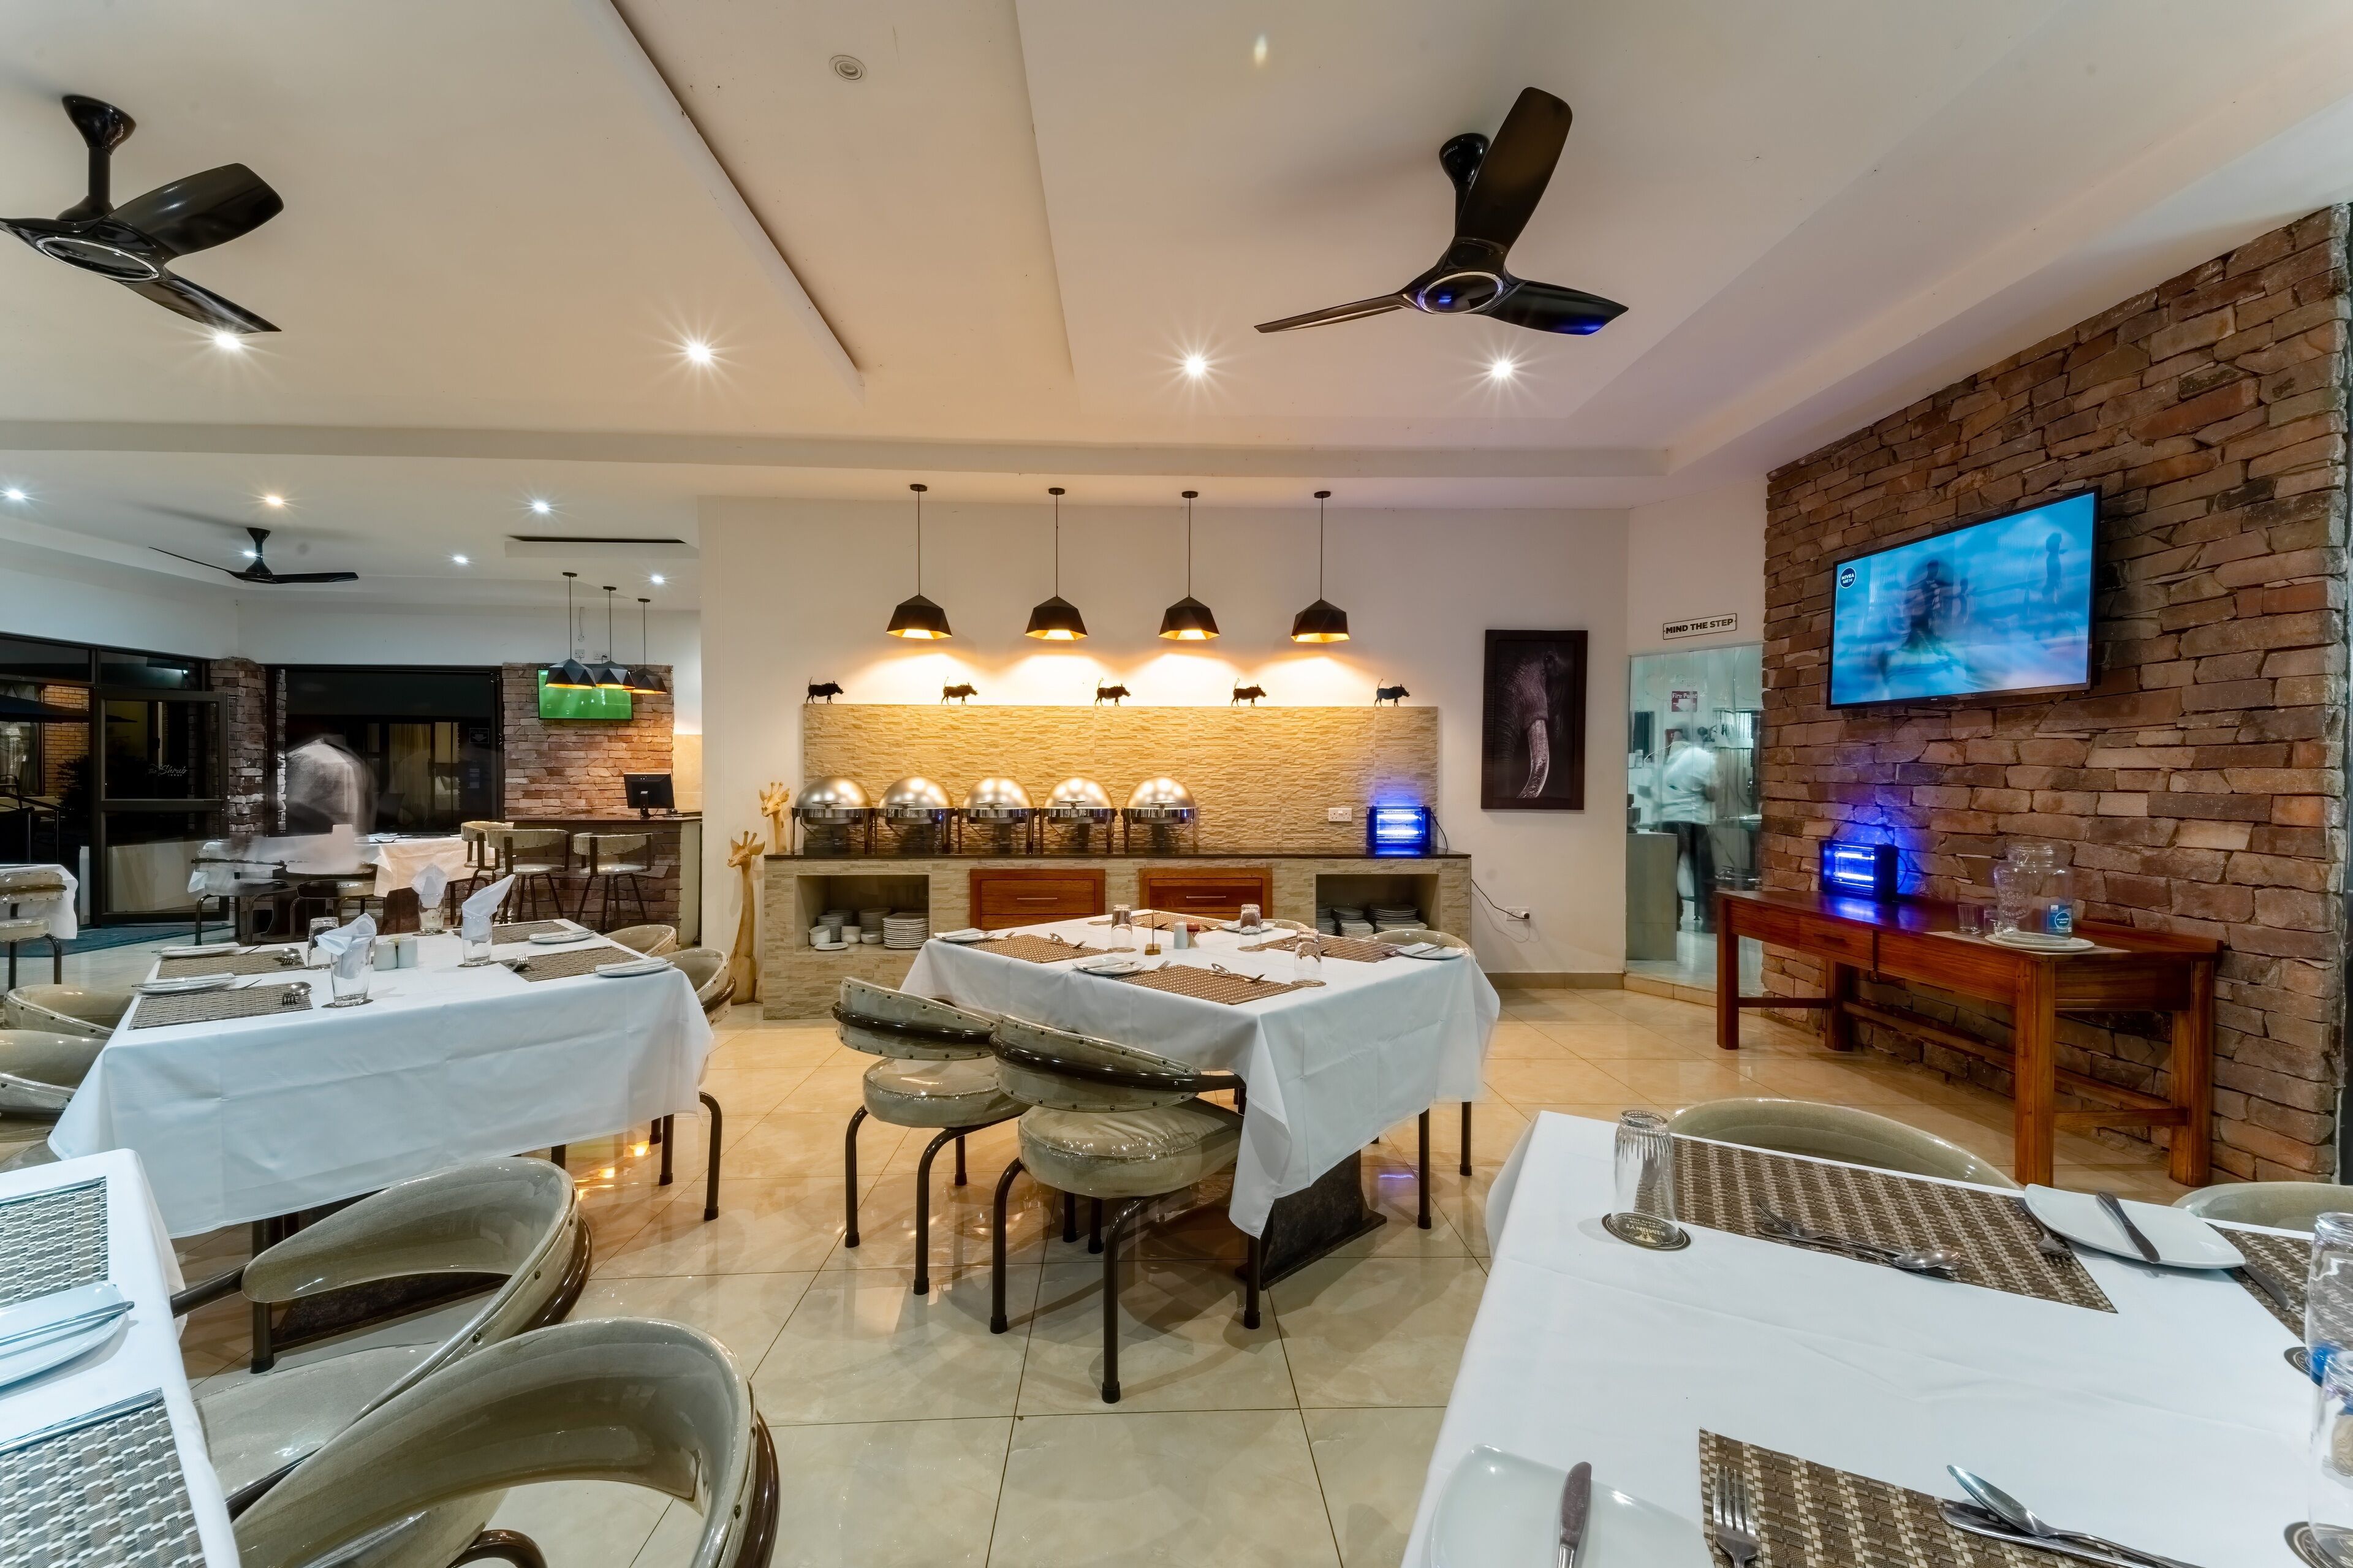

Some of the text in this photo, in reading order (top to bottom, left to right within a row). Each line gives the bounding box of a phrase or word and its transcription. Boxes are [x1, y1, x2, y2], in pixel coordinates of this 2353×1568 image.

[1665, 618, 1733, 634] MIND THE STEP
[1625, 1223, 1666, 1237] SIMUNYE
